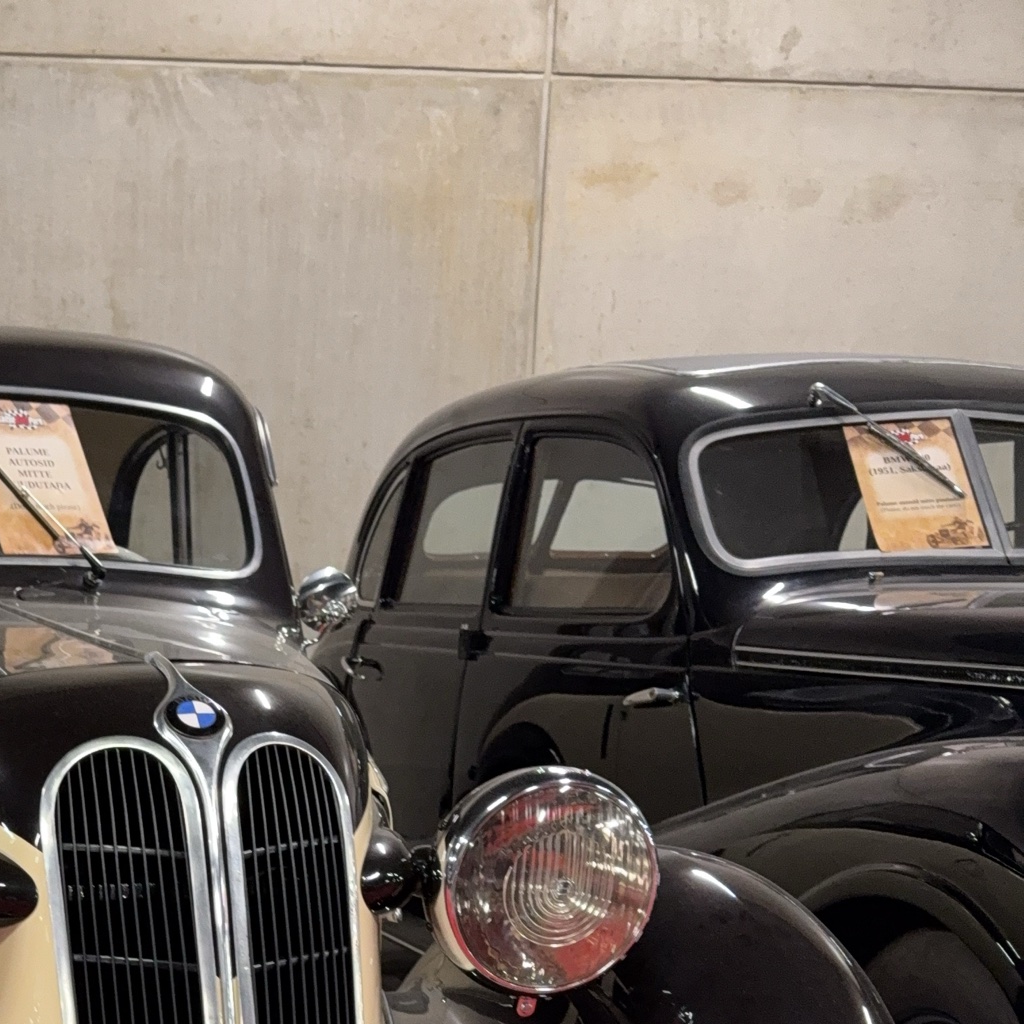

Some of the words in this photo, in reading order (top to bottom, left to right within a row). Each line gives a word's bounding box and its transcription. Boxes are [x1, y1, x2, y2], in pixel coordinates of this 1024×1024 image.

[5, 446, 50, 457] PALUME
[9, 458, 55, 468] AUTOSID
[17, 470, 52, 479] MITTE
